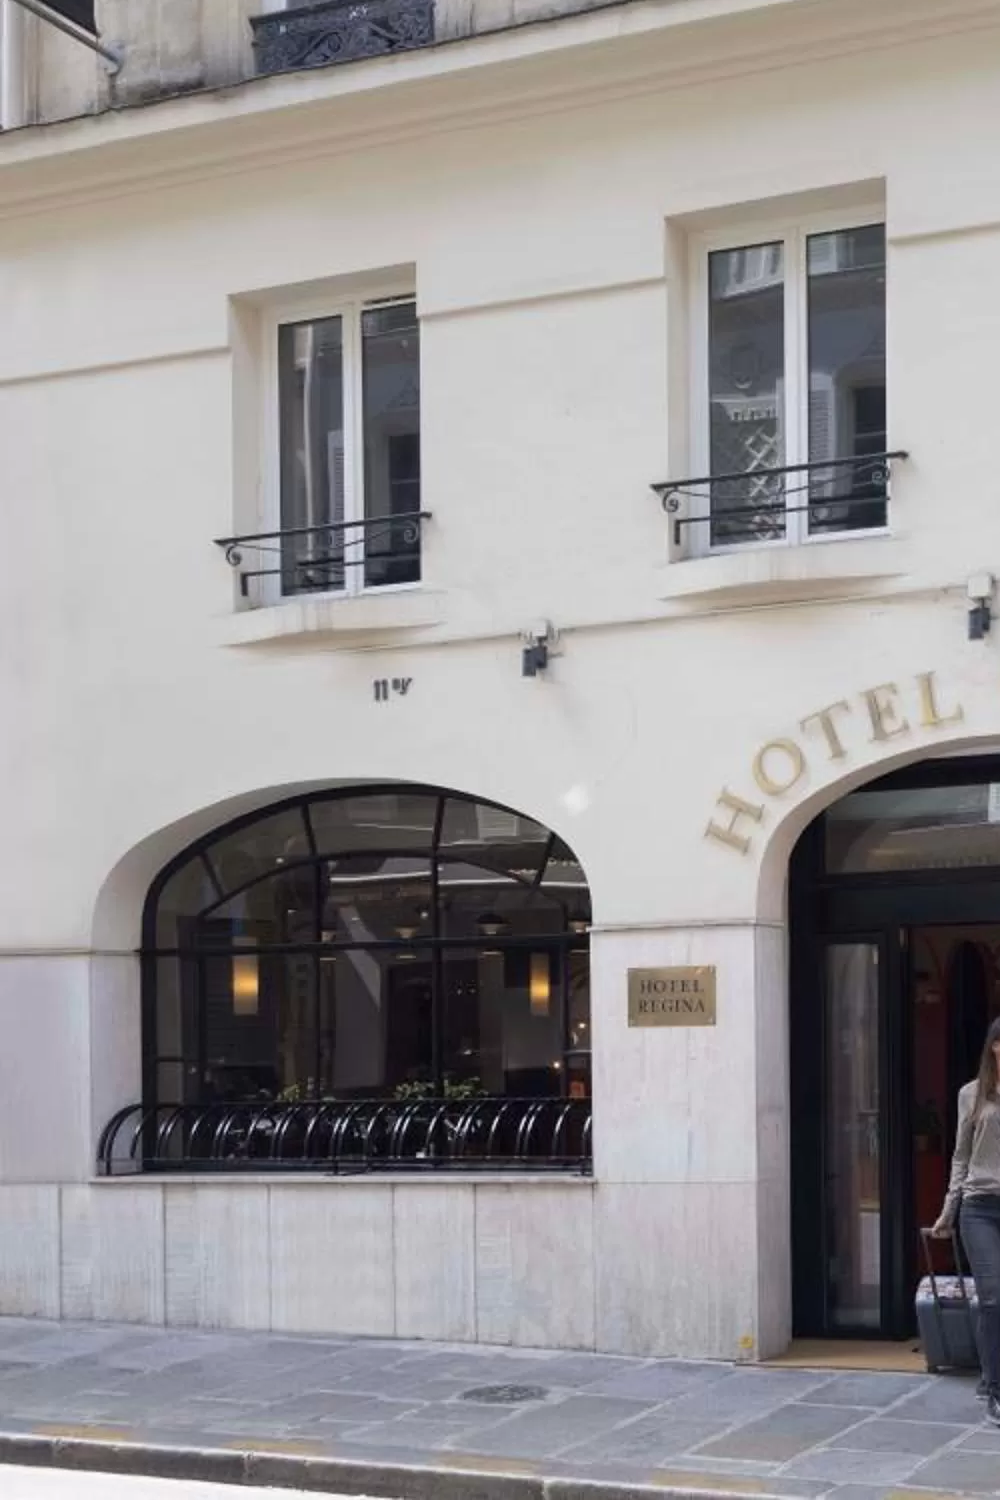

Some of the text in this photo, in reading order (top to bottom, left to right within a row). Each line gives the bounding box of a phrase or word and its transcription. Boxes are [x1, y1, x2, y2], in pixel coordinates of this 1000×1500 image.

[703, 670, 965, 856] HOTEL
[640, 979, 705, 994] HOTEL
[638, 999, 705, 1013] REGINA
